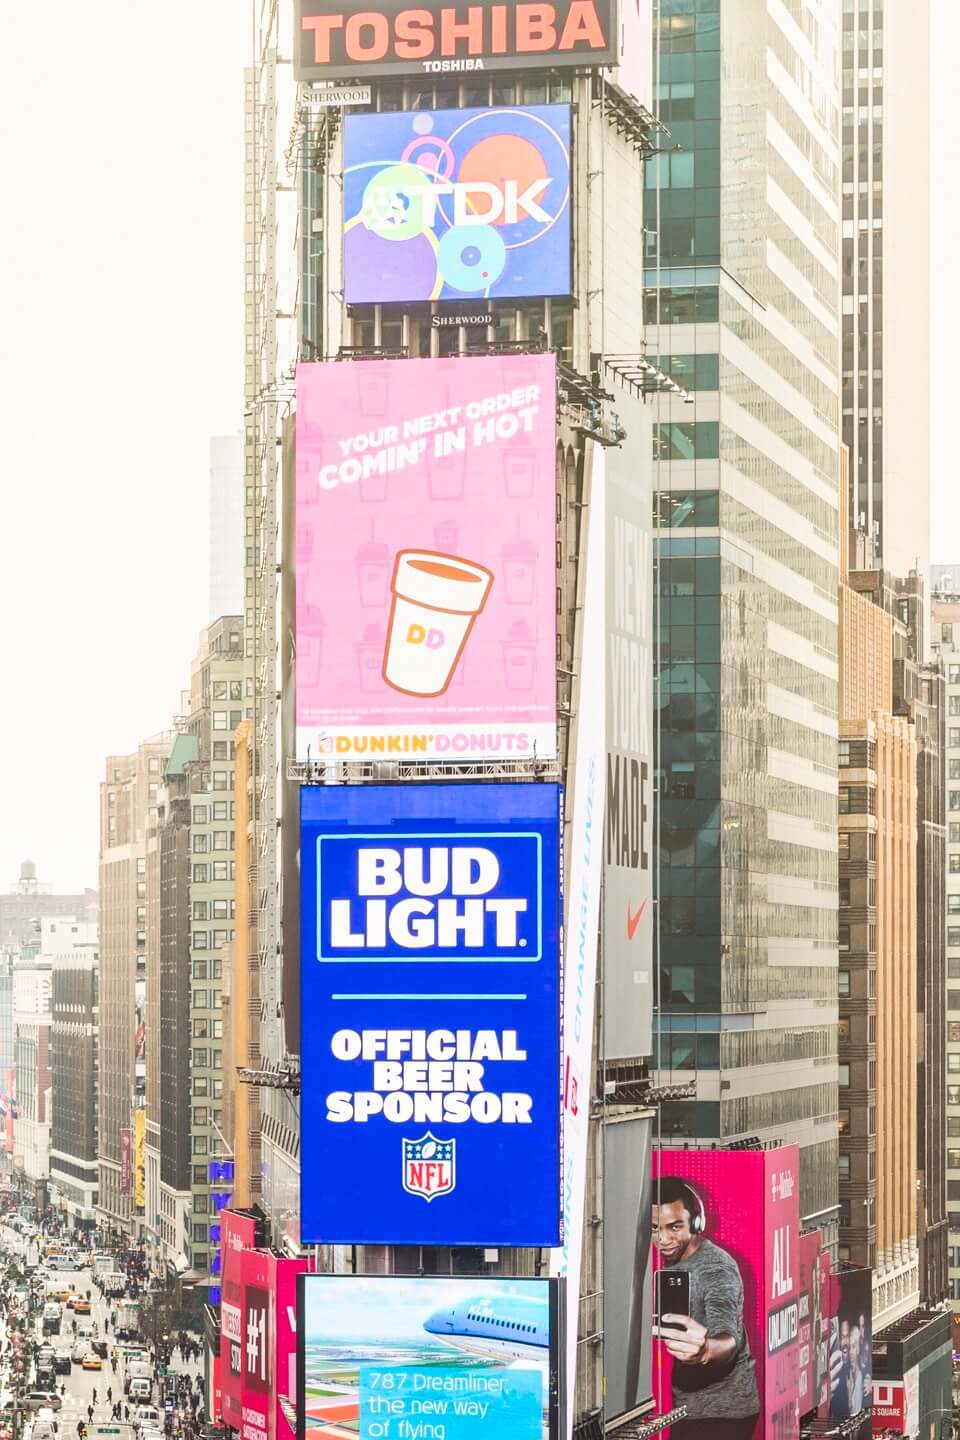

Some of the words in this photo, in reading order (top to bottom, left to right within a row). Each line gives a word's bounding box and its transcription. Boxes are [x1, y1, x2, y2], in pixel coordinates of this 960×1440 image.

[301, 0, 607, 63] TOSHIBA
[423, 59, 484, 73] TOSHIBA
[302, 90, 370, 103] SHERWOOD
[409, 178, 554, 227] TDK
[432, 314, 492, 327] SHERWOOD
[339, 425, 398, 458] YOUR
[403, 407, 461, 439] NEXT
[465, 385, 540, 418] ORDER
[318, 440, 427, 489] COMIN'
[434, 427, 466, 459] IN
[473, 406, 540, 450] HOT
[406, 624, 445, 650] DD
[607, 752, 649, 870] MADE
[357, 846, 500, 897] BUD
[330, 1028, 528, 1061] OFFICIAL
[373, 1060, 485, 1092] BEER
[325, 1091, 533, 1124] SPONSOR
[409, 1161, 449, 1191] NFL
[771, 1225, 793, 1300] ALL
[769, 1303, 798, 1352] UNLIMITED
[369, 1372, 407, 1389] 787
[368, 1396, 405, 1414] the
[411, 1400, 447, 1415] new
[453, 1402, 489, 1419] way
[877, 1408, 901, 1416] SQUARE
[368, 1421, 390, 1437] of
[398, 1419, 445, 1440] flying
